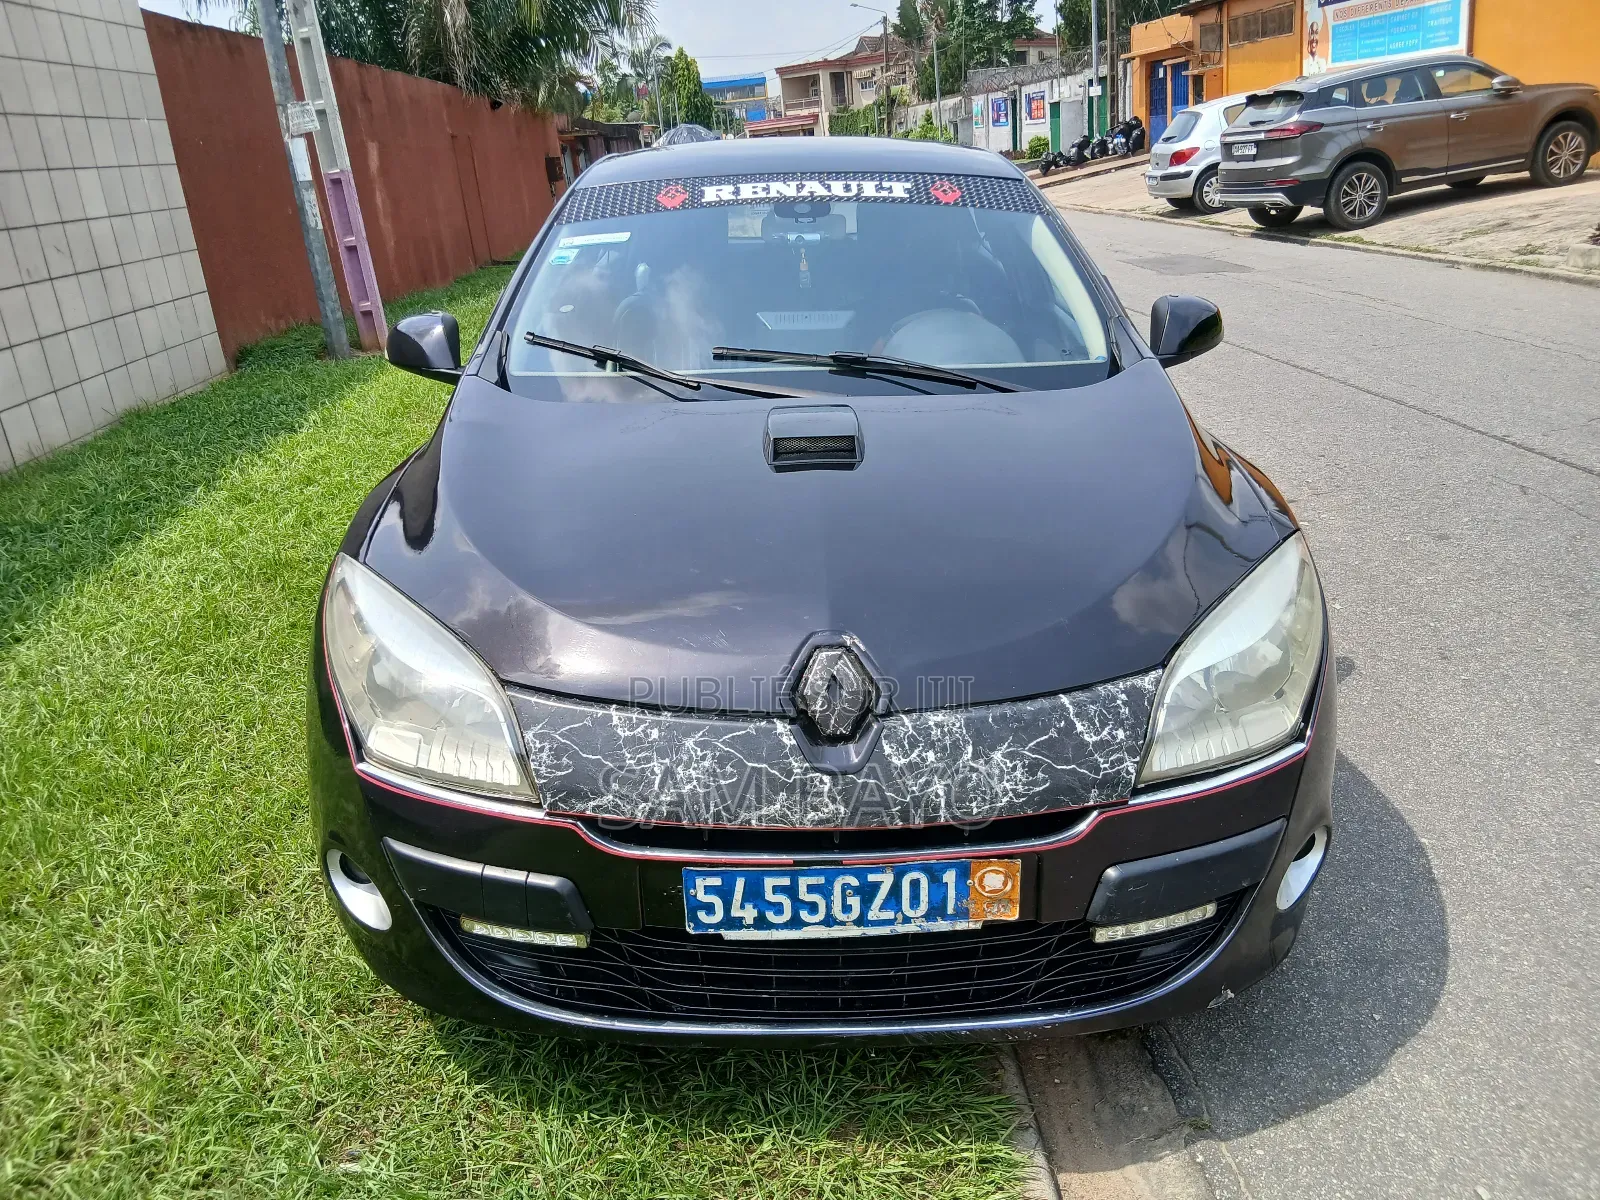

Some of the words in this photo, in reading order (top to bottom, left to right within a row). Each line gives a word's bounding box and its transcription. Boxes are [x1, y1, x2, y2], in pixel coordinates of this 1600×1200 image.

[1335, 9, 1347, 19] NOS
[701, 181, 911, 201] RENAULT
[694, 869, 957, 925] 5455GZ01
